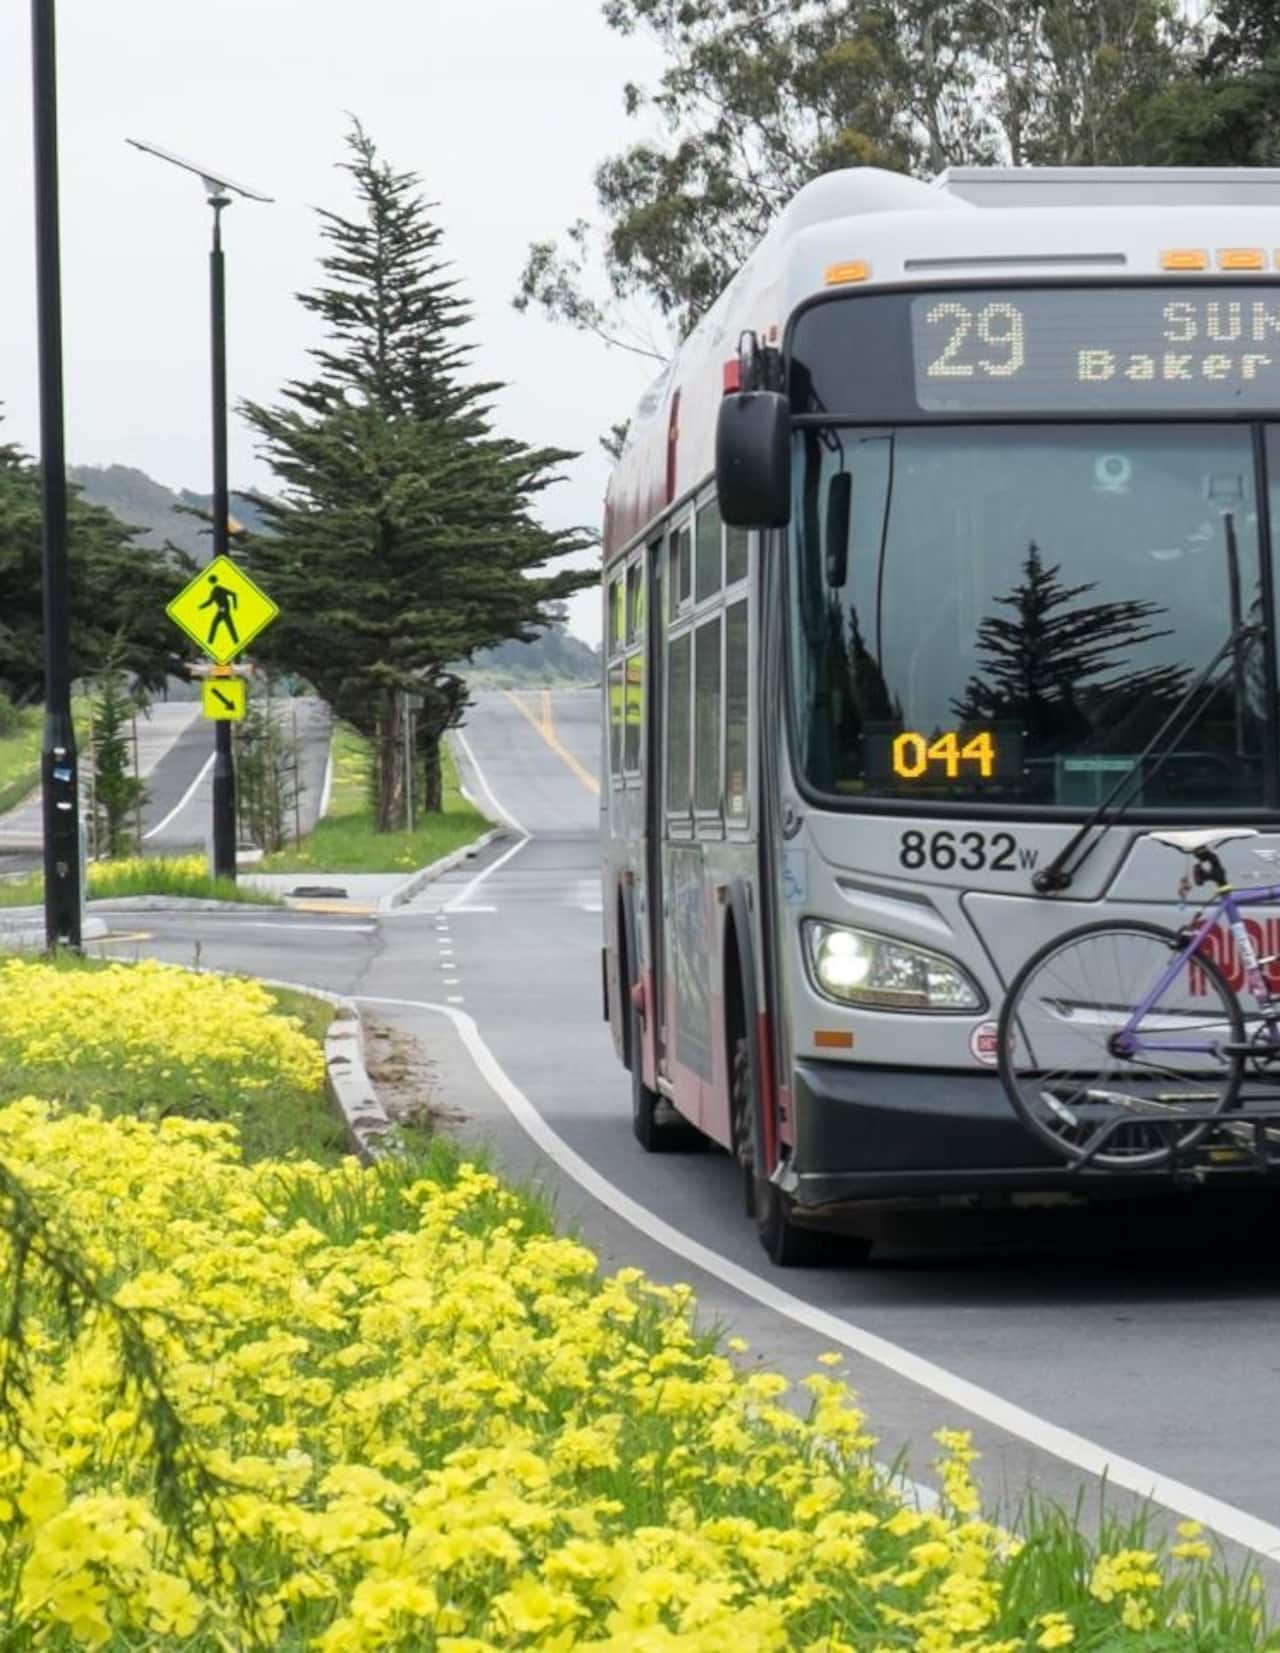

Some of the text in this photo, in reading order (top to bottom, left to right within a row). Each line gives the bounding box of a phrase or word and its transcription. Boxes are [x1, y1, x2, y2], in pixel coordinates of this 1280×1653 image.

[925, 302, 1024, 377] 29
[1077, 349, 1273, 380] Baker
[892, 731, 995, 778] 044
